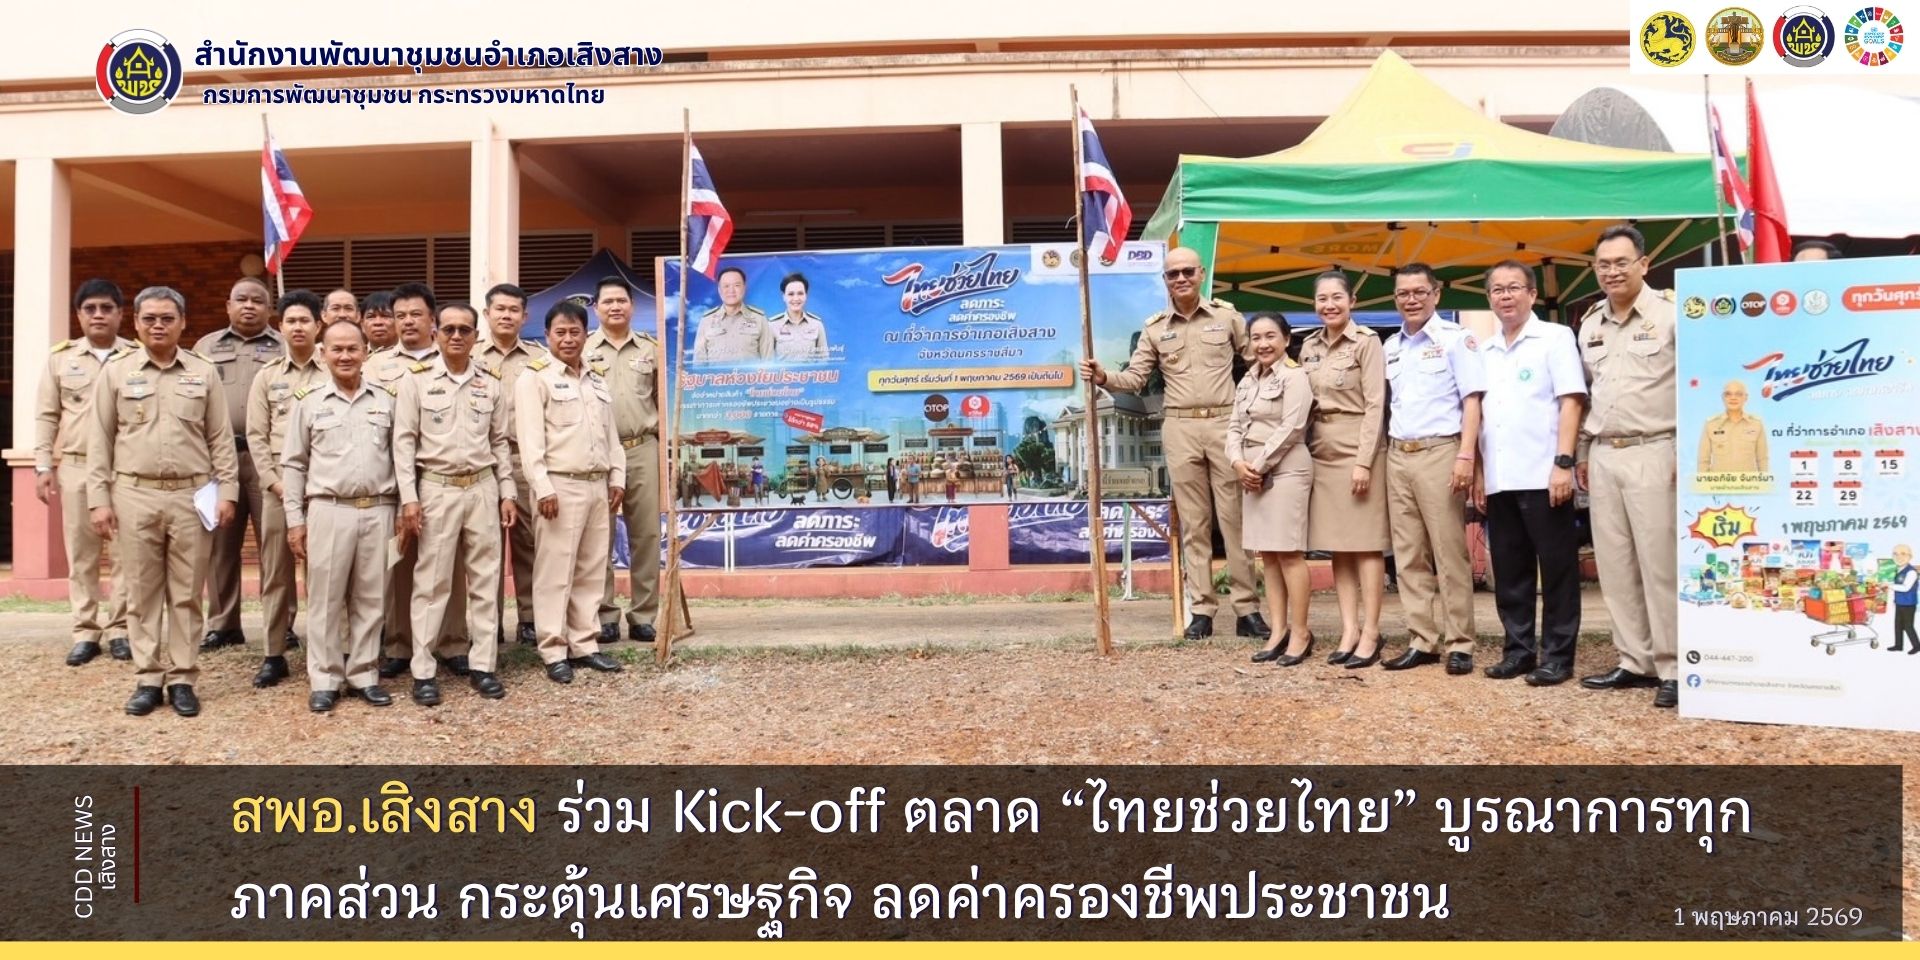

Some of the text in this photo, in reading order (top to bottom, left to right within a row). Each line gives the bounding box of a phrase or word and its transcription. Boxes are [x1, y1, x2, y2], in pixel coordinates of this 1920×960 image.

[1741, 300, 1767, 309] OTOP
[1002, 371, 1026, 381] 2569
[924, 403, 950, 413] OTOP
[1786, 422, 1866, 437] ที่ว่าการอำเภอ
[1801, 459, 1899, 471] 1 8 15
[1795, 490, 1858, 501] 22 29
[793, 514, 861, 529] ลดภาระ
[1712, 511, 1740, 536] เริ่ม
[1791, 517, 1868, 538] พฤษภาคม
[1872, 515, 1908, 529] 2569
[774, 532, 877, 548] ลดค่าครองชีพ
